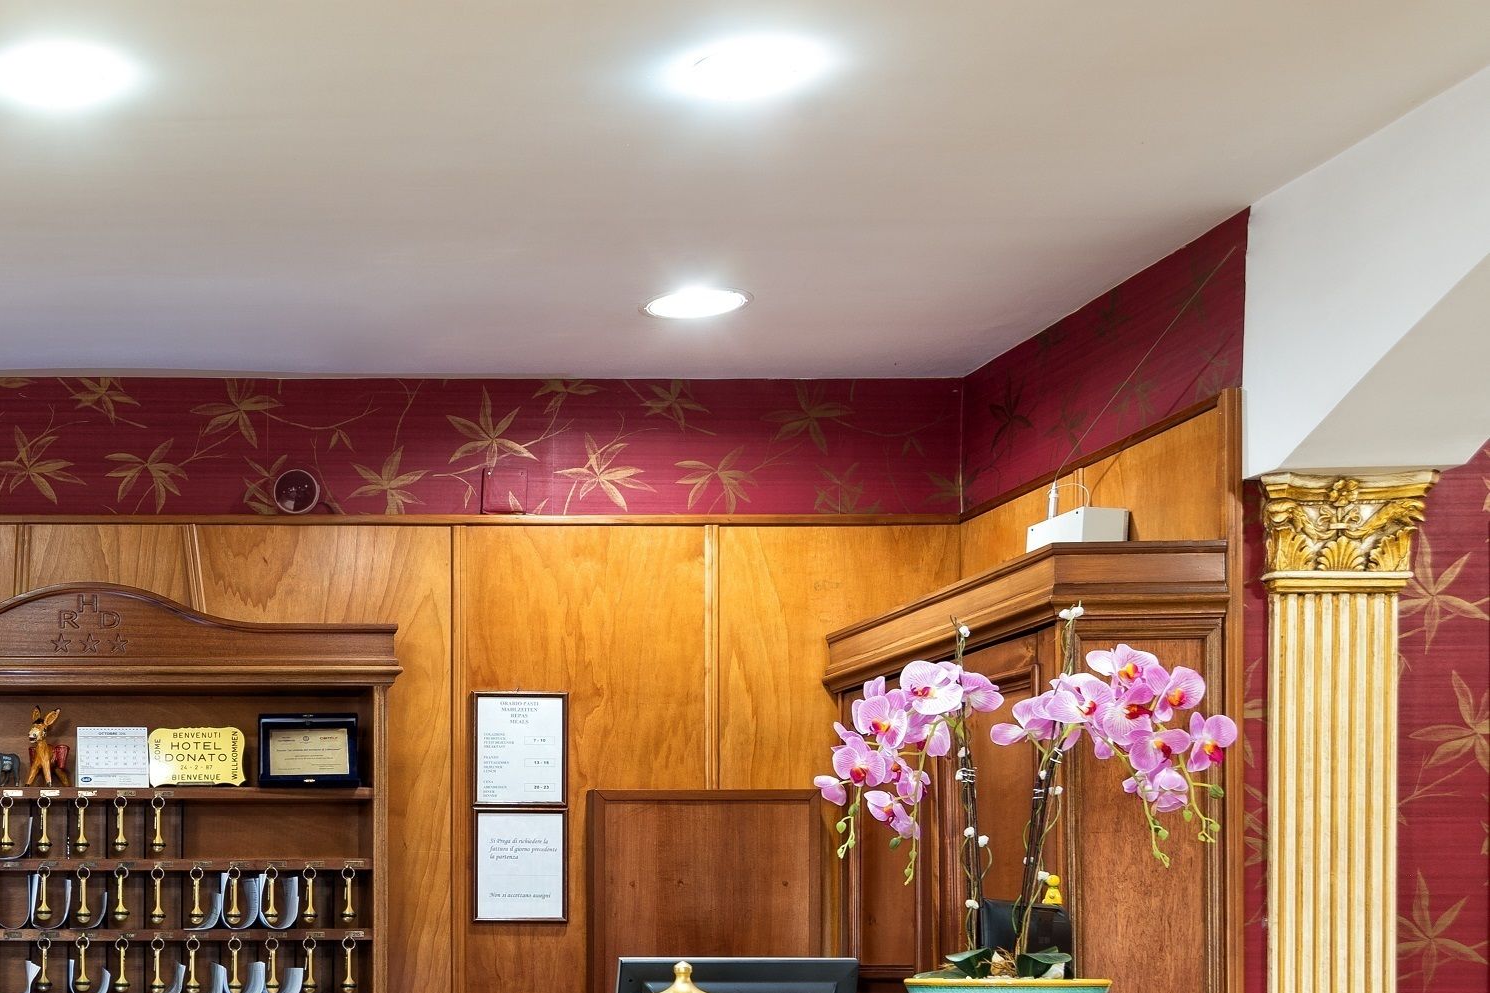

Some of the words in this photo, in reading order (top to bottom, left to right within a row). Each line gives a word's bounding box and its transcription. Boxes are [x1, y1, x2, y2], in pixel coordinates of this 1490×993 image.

[170, 741, 222, 751] HOTEL
[164, 753, 228, 762] DONATO
[231, 731, 239, 780] WILLKOMMEN
